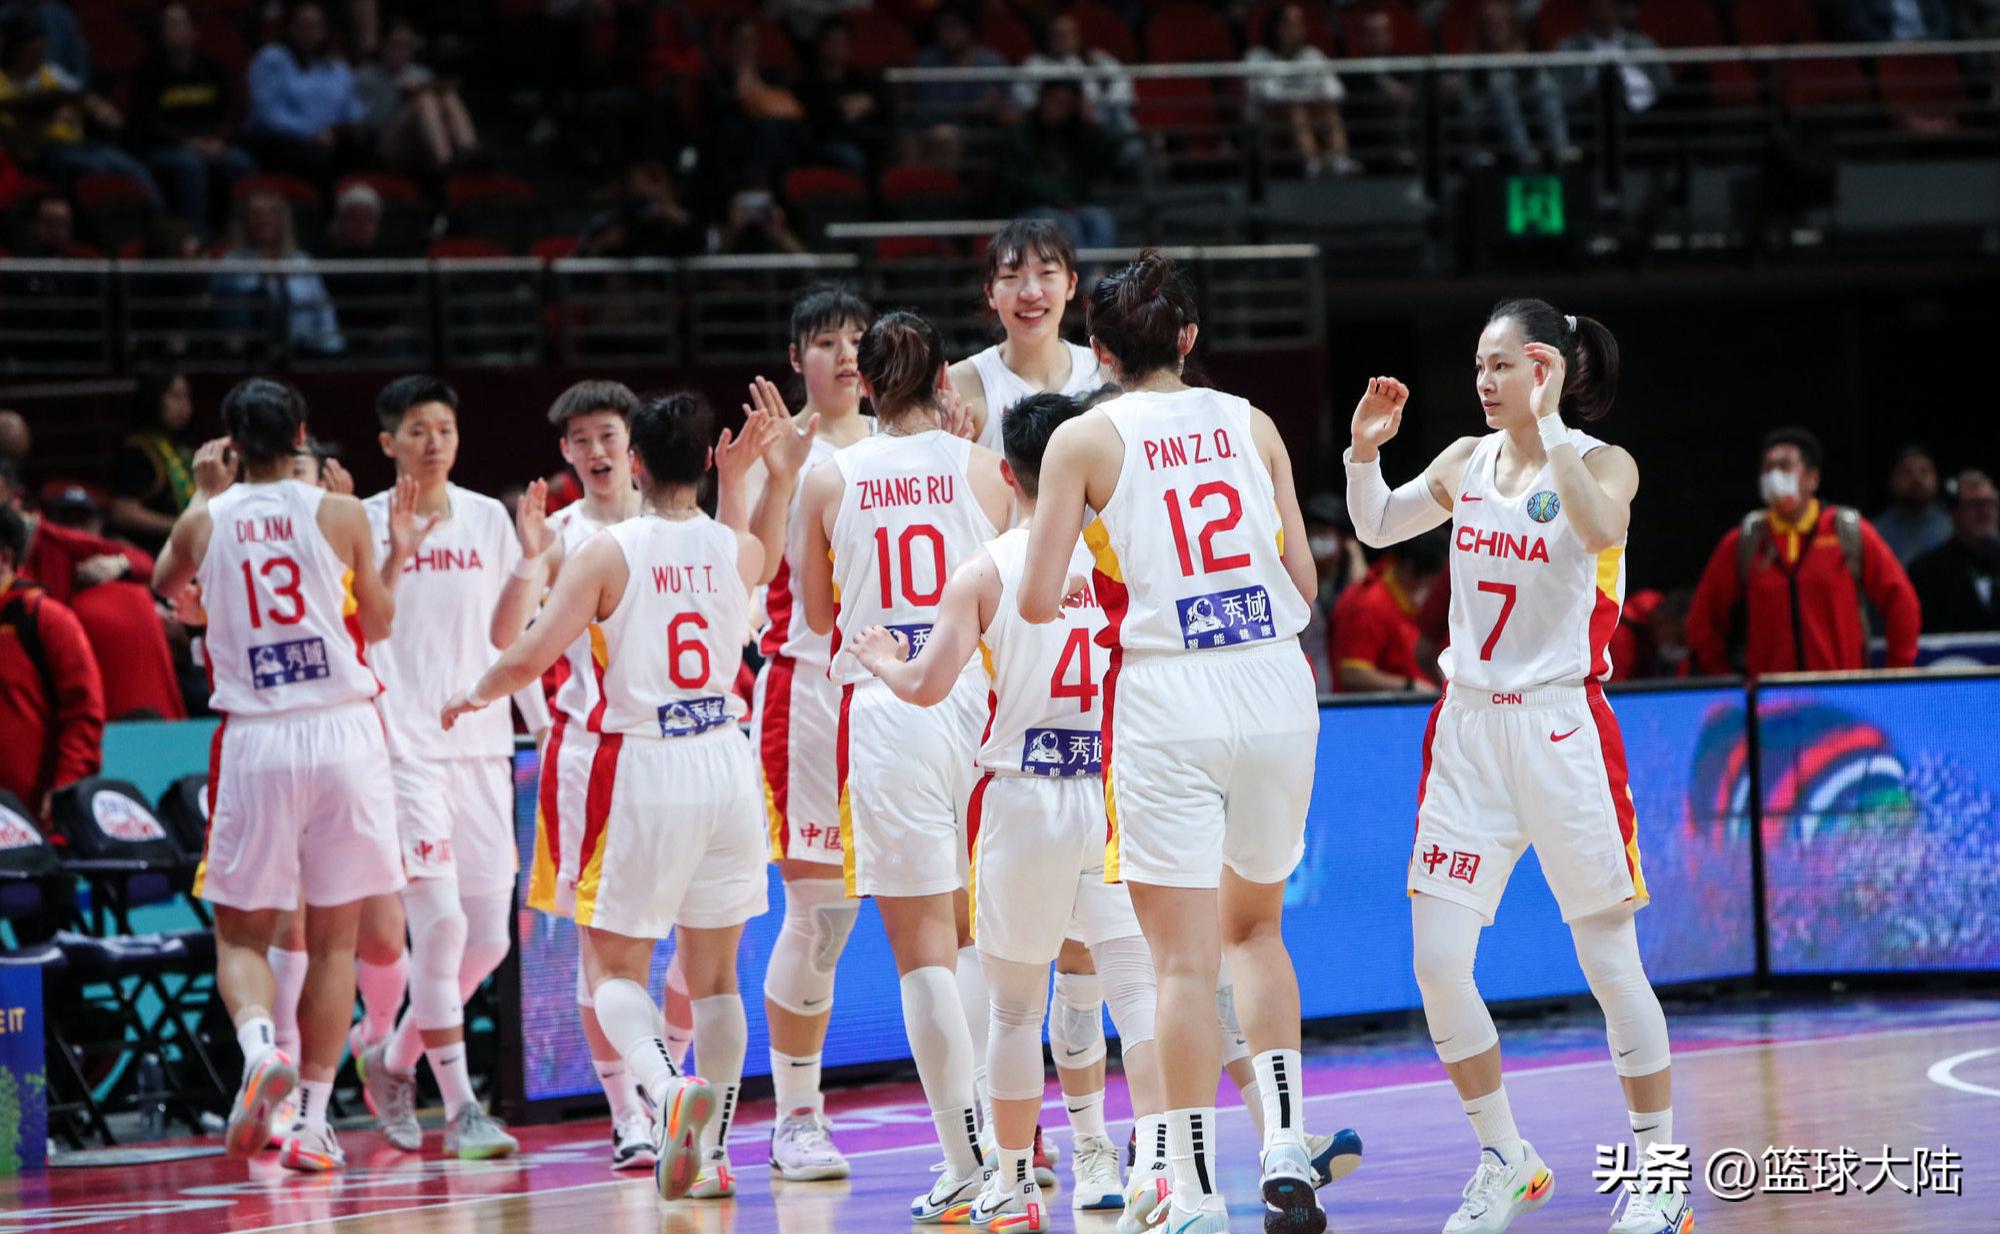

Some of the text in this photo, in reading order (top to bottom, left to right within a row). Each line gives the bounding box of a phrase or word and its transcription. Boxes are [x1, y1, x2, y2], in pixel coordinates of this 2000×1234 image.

[1144, 435, 1188, 471] PAN
[857, 475, 954, 511] ZHANG RU
[236, 516, 293, 544] DILANA
[1163, 480, 1251, 577] 12
[1456, 525, 1549, 563] CHINA
[403, 548, 483, 573] HINA
[875, 524, 946, 609] 10
[241, 555, 305, 629] 13
[1221, 590, 1270, 627] 秀域
[1477, 580, 1517, 661] 7
[667, 612, 710, 689] 6
[1051, 628, 1098, 713] 4
[1492, 693, 1522, 705] CHN
[1423, 844, 1480, 884] 中国
